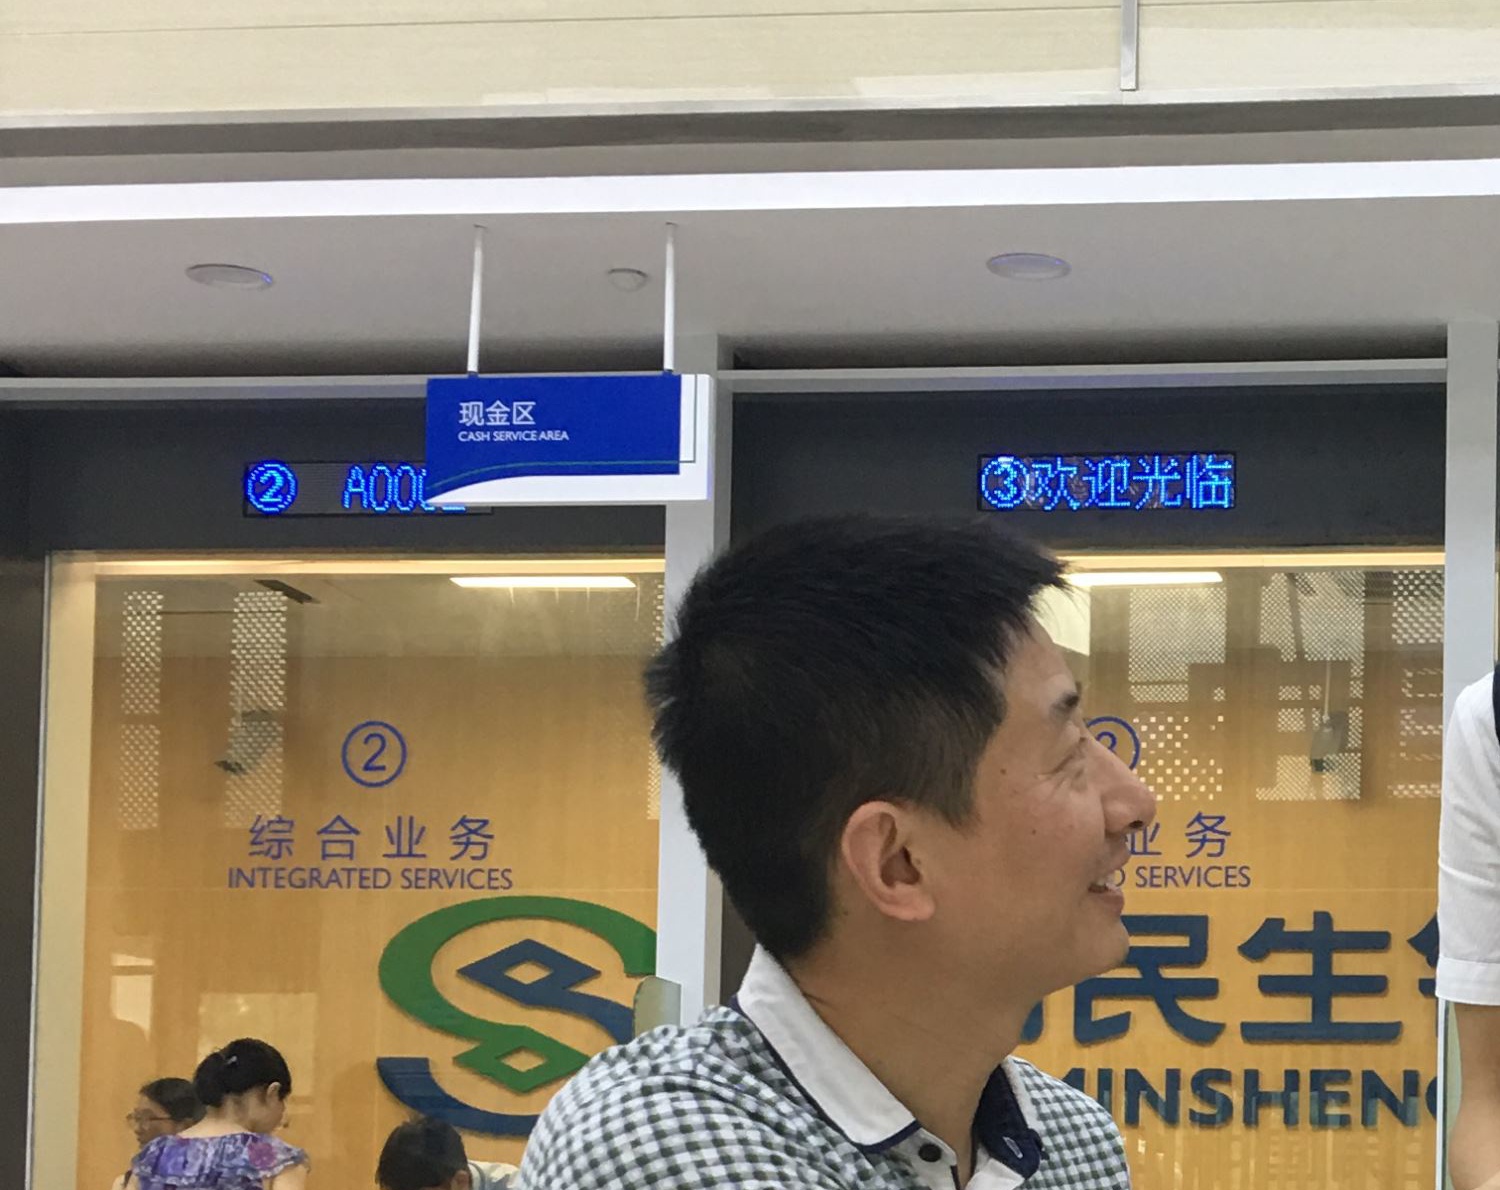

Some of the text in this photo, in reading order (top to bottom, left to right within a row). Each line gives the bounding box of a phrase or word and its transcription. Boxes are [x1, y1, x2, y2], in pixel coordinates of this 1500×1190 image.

[458, 400, 536, 426] 现金区
[458, 430, 569, 441] CASH SERVICE AREA
[248, 814, 494, 861] 综合业务
[228, 867, 513, 890] INTEGRATED SERVICES
[1135, 866, 1251, 888] SERVICES
[1020, 911, 1438, 1045] 民生
[1061, 1066, 1437, 1130] INSHEN
